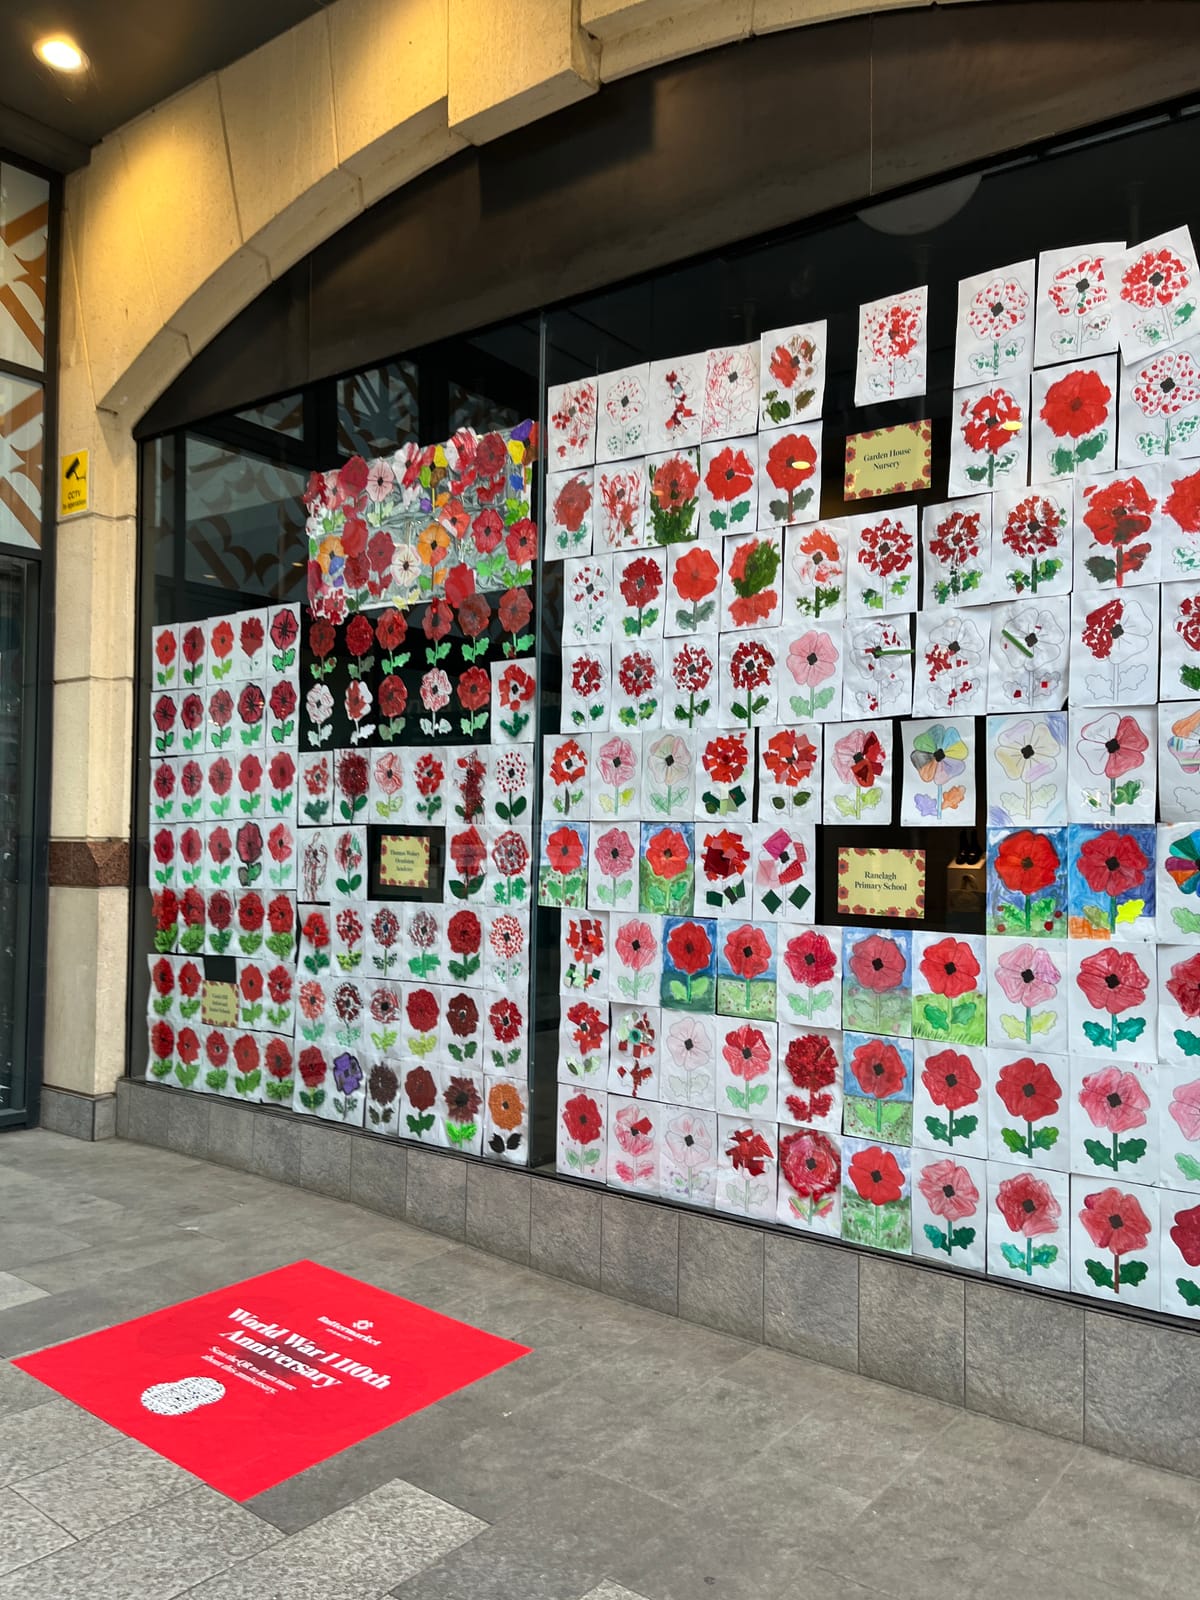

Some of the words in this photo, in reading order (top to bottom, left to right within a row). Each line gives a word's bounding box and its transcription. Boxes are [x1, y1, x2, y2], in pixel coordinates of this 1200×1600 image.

[863, 452, 888, 462] Garden
[889, 448, 911, 458] House
[874, 461, 900, 470] Nursery
[68, 490, 81, 500] CCTV
[865, 871, 896, 880] Ranelagh
[855, 882, 882, 892] Primary
[883, 882, 907, 891] School
[318, 1316, 381, 1346] Buttermarket
[228, 1308, 290, 1339] World
[284, 1333, 326, 1357] War
[330, 1358, 390, 1389] 110th
[201, 1355, 224, 1366] about
[218, 1364, 237, 1373] this
[219, 1330, 342, 1388] Anniversary
[210, 1346, 227, 1356] Scan
[233, 1360, 253, 1369] QR
[273, 1379, 296, 1390] more
